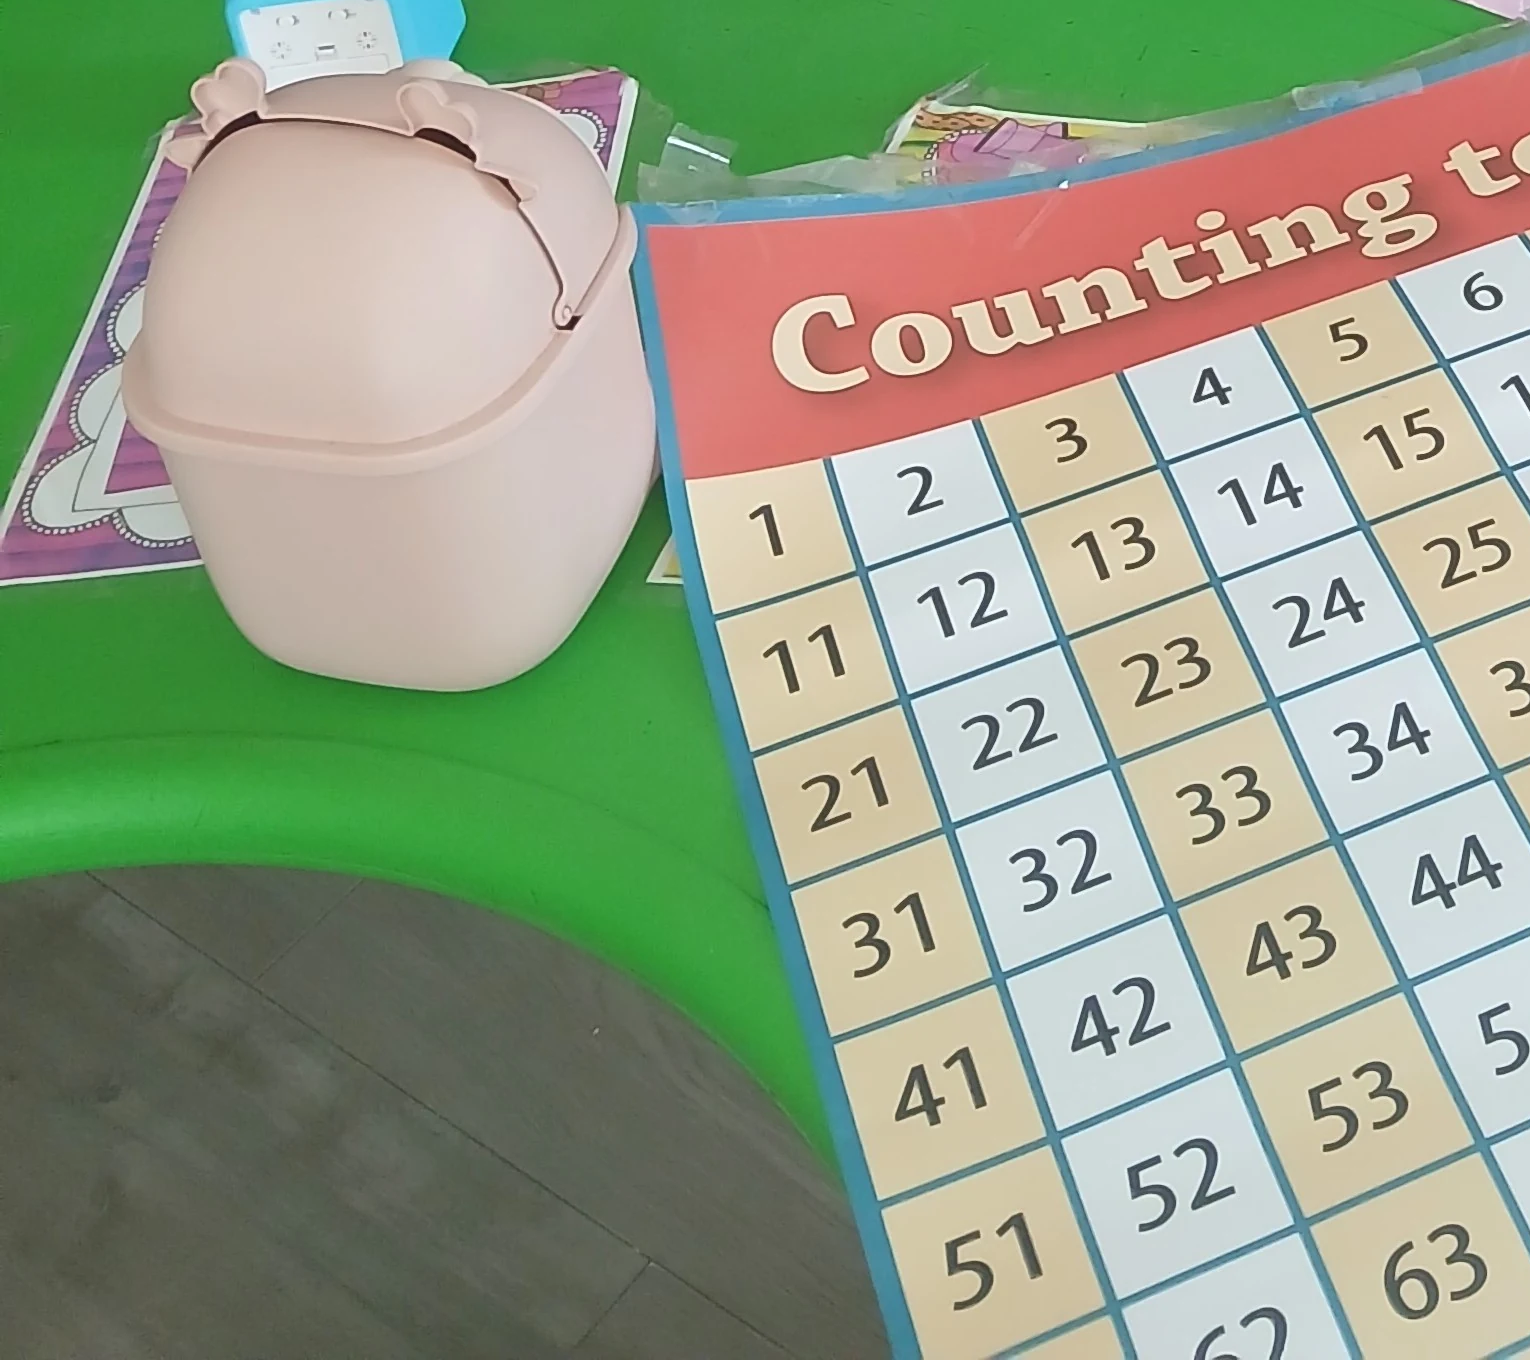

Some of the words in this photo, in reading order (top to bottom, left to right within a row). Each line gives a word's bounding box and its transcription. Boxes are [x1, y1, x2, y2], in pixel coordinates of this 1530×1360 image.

[748, 503, 787, 560] 1
[896, 465, 947, 519] 2
[1044, 416, 1091, 466] 3
[1191, 366, 1235, 409] 4
[1328, 316, 1371, 365] 5
[1462, 270, 1507, 314] 6
[770, 168, 1439, 395] Counting
[841, 891, 939, 981] 31
[1008, 828, 1115, 916] 32
[1174, 764, 1274, 848] 33
[1332, 700, 1434, 784] 34
[944, 1211, 1046, 1314] 51
[1126, 1137, 1239, 1236] 52
[1307, 1060, 1412, 1156] 53
